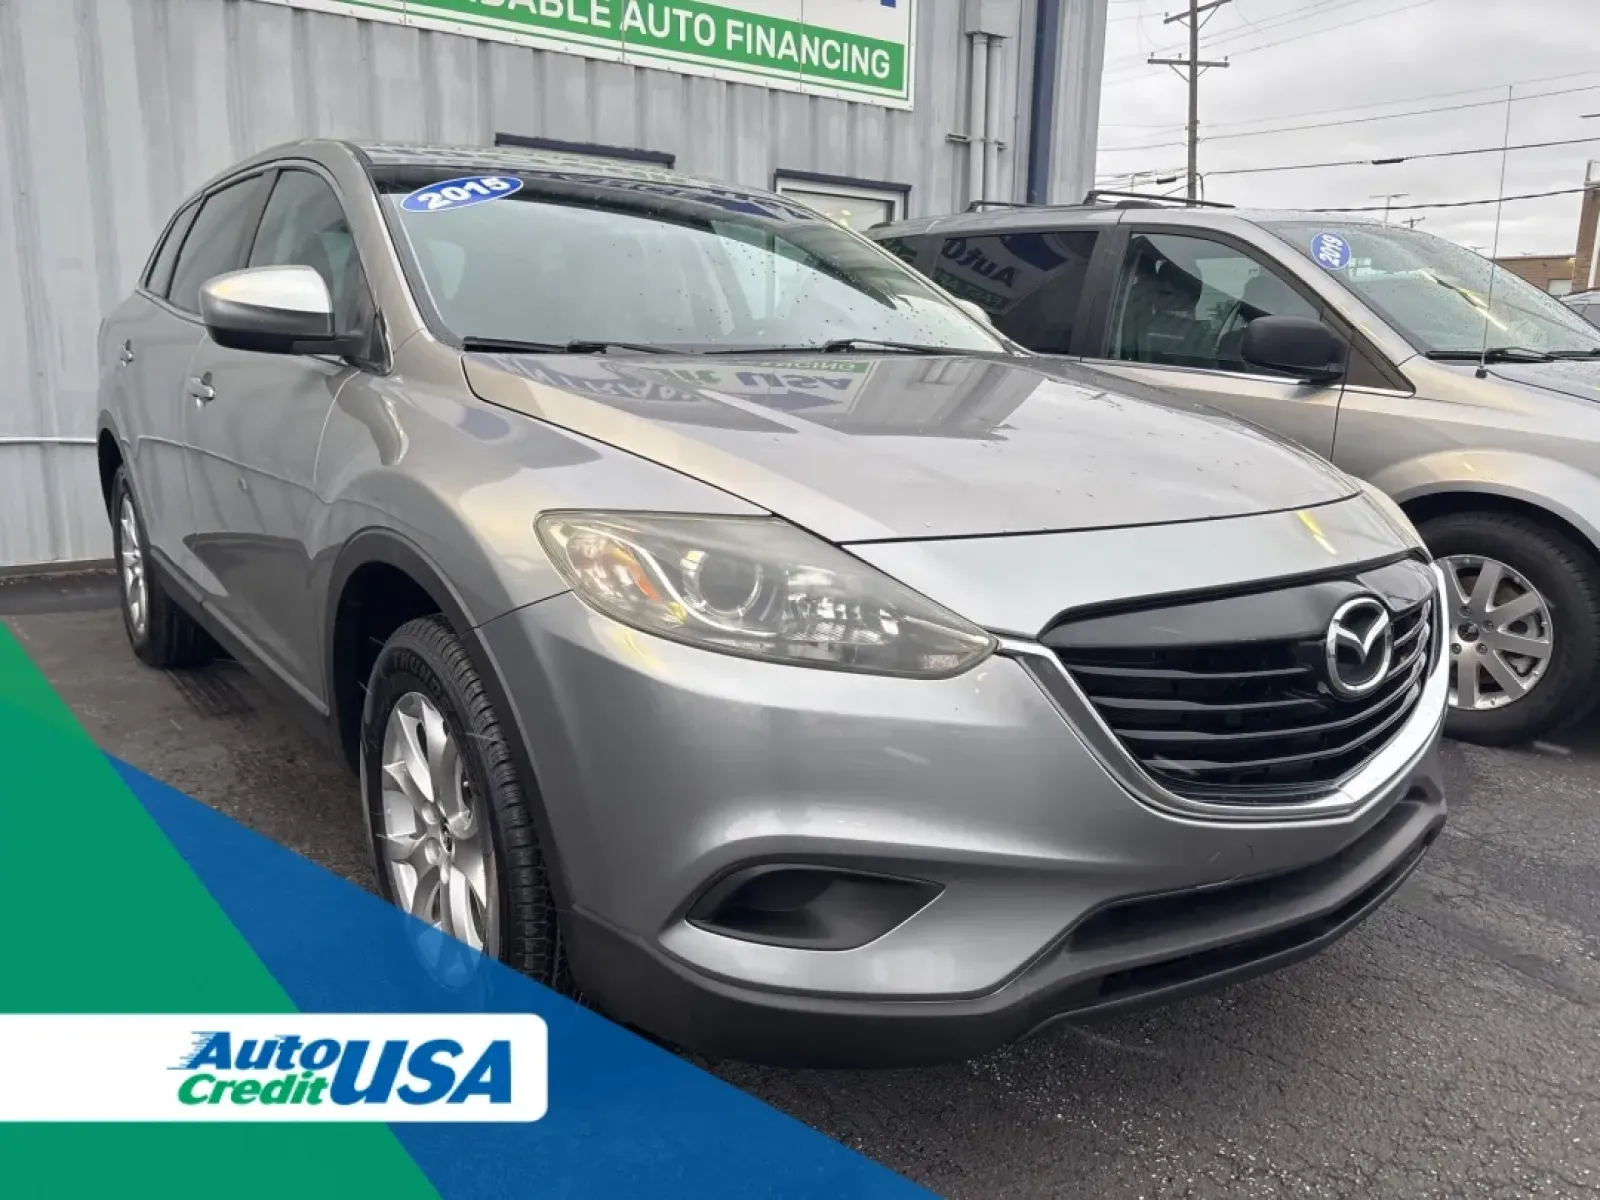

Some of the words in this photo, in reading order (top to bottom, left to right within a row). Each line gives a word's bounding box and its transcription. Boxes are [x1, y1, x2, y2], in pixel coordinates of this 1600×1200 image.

[620, 0, 716, 47] AUTO
[726, 18, 890, 79] FINANCING
[417, 177, 511, 210] 2015
[1319, 233, 1343, 267] 2019
